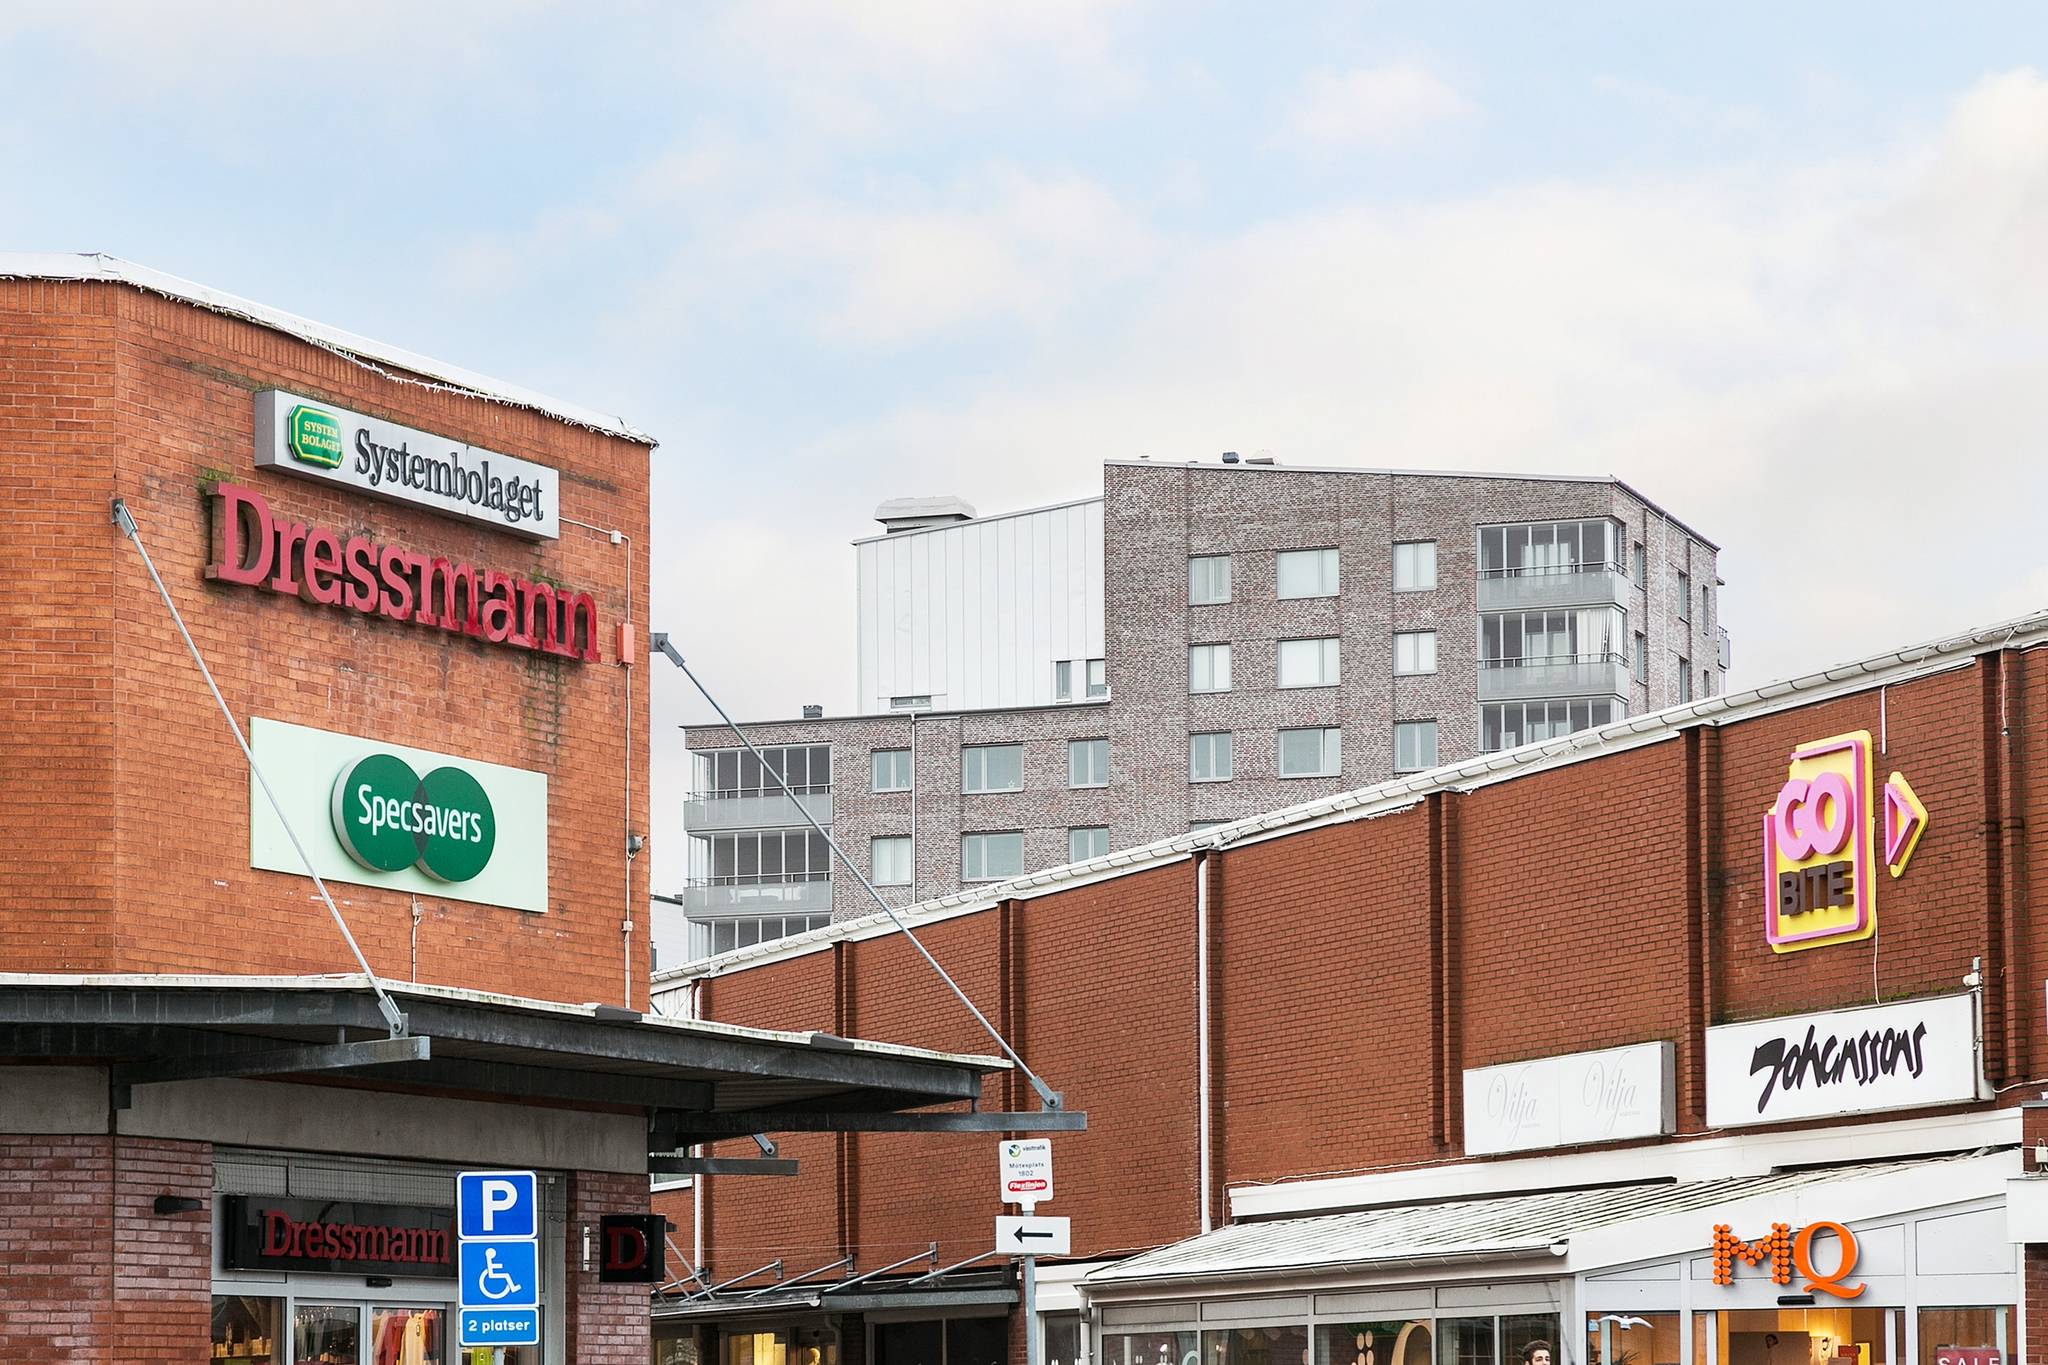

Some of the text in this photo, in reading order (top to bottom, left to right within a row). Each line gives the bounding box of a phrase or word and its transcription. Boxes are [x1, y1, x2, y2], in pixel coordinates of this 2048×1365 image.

[301, 433, 342, 453] BOLAGET
[304, 420, 338, 438] SYSTEM
[355, 428, 543, 522] Systembolaget
[204, 481, 602, 664] Dressmann
[358, 784, 482, 843] Specsavers
[1775, 772, 1854, 862] GO
[1779, 860, 1854, 918] BITE
[1583, 1050, 1638, 1136] Vilja
[1750, 1021, 1927, 1114] Johanssons
[1487, 1065, 1538, 1146] Vilja
[482, 1180, 518, 1231] P
[261, 1208, 451, 1265] Dressmann
[606, 1225, 647, 1271] D
[1713, 1221, 1867, 1299] MQ
[468, 1318, 531, 1335] 2 platser
